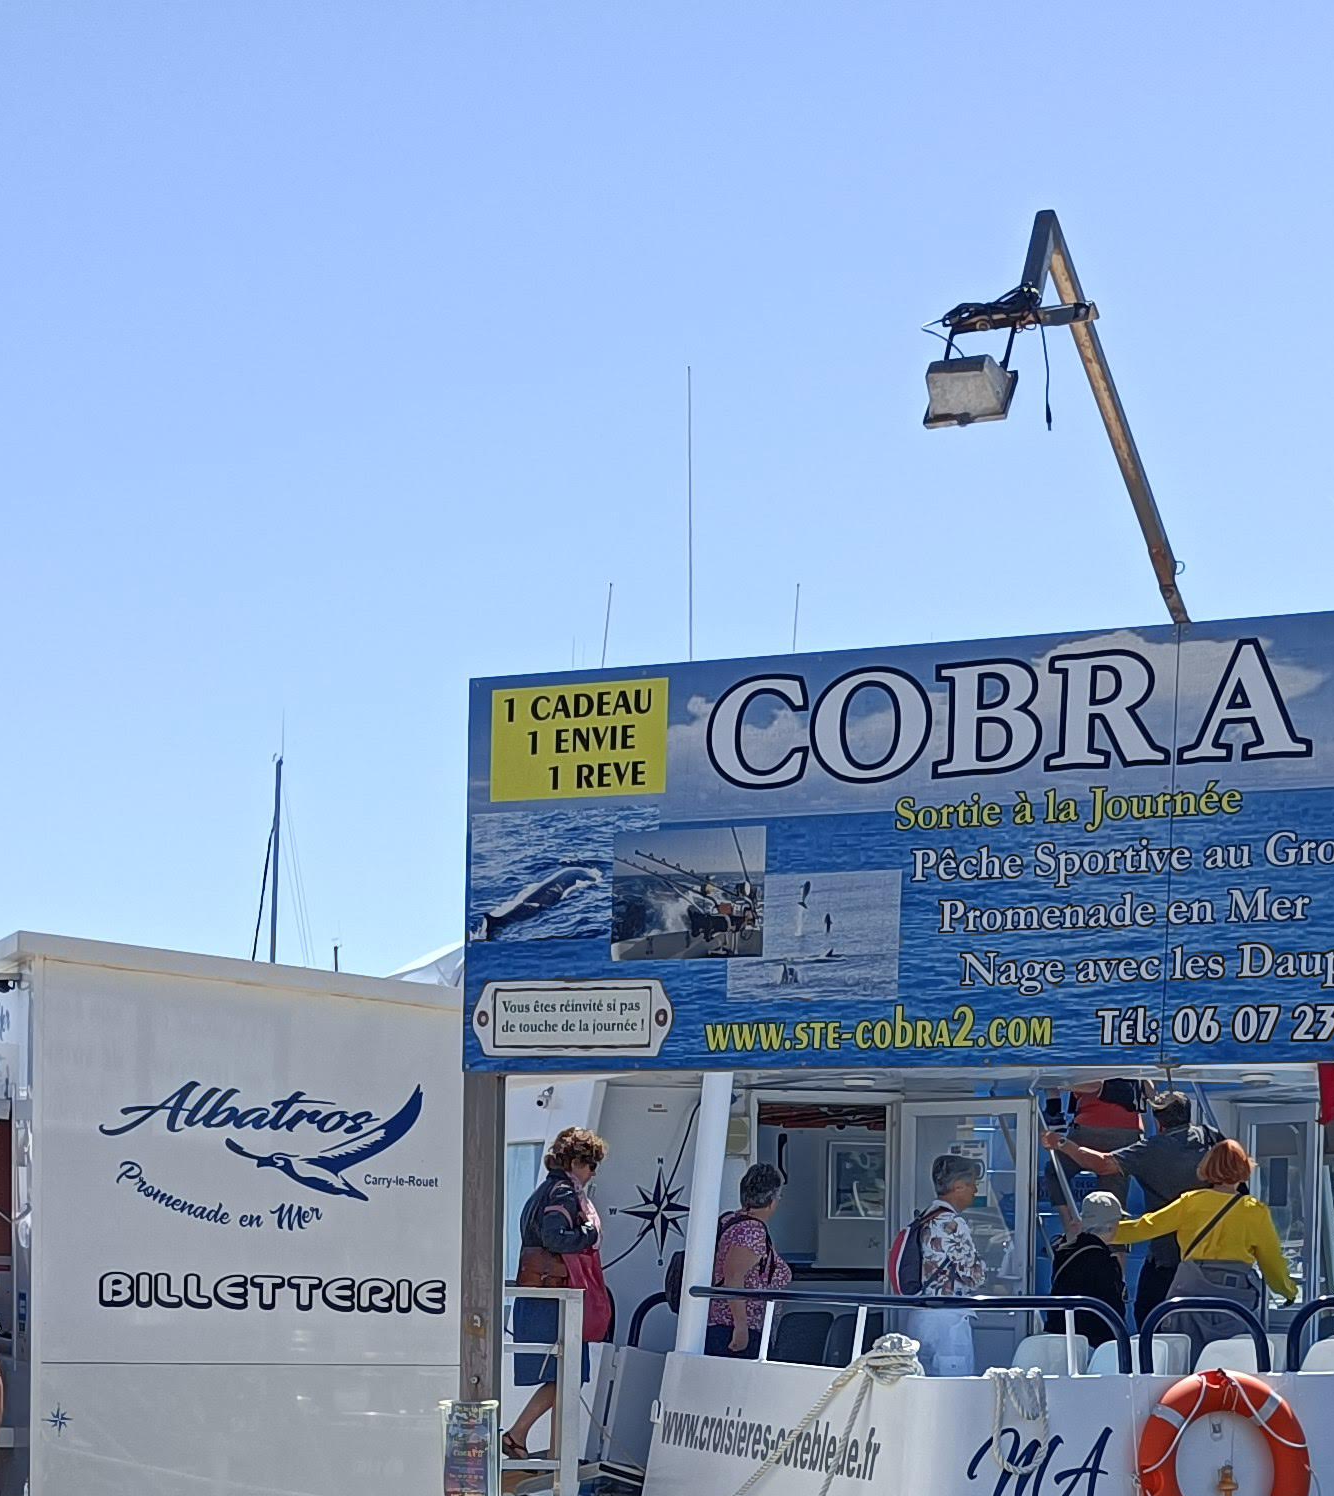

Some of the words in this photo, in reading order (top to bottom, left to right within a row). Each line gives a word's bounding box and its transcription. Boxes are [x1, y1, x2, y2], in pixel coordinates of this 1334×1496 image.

[503, 697, 516, 723] 1
[530, 687, 653, 722] CADEAU
[706, 638, 1313, 790] COBRA
[526, 730, 538, 755] 1
[554, 725, 636, 754] ENVIE
[548, 766, 560, 791] 1
[575, 760, 646, 789] REVE
[895, 792, 1002, 831] Sortie
[1013, 791, 1035, 824] à
[1044, 789, 1077, 823] la
[1084, 780, 1242, 833] Journée
[911, 840, 1023, 882] Pêche
[1034, 837, 1192, 888] Sportive
[1203, 841, 1250, 870] au
[939, 891, 1156, 933] Promenade
[1167, 897, 1214, 926] en
[1227, 887, 1311, 922] Mer
[960, 952, 1065, 994] Nage
[1076, 953, 1160, 984] avec
[1171, 946, 1225, 980] les
[501, 1020, 515, 1033] de
[519, 1020, 558, 1033] touche
[561, 1020, 575, 1032] de
[578, 1019, 590, 1032] la
[592, 1018, 637, 1035] journée
[502, 1000, 530, 1013] Vous
[534, 1000, 556, 1013] êtes
[560, 998, 603, 1012] réinvité
[606, 998, 616, 1012] si
[619, 1001, 640, 1015] pas
[1173, 1006, 1222, 1044] 06
[1232, 1005, 1281, 1042] 07
[99, 1081, 389, 1136] Albatros
[117, 1161, 231, 1226] Promenade
[239, 1213, 264, 1229] en
[270, 1203, 323, 1231] Mer
[364, 1174, 438, 1188] Carry-le-Rouet
[99, 1271, 447, 1315] BILLETTERIE
